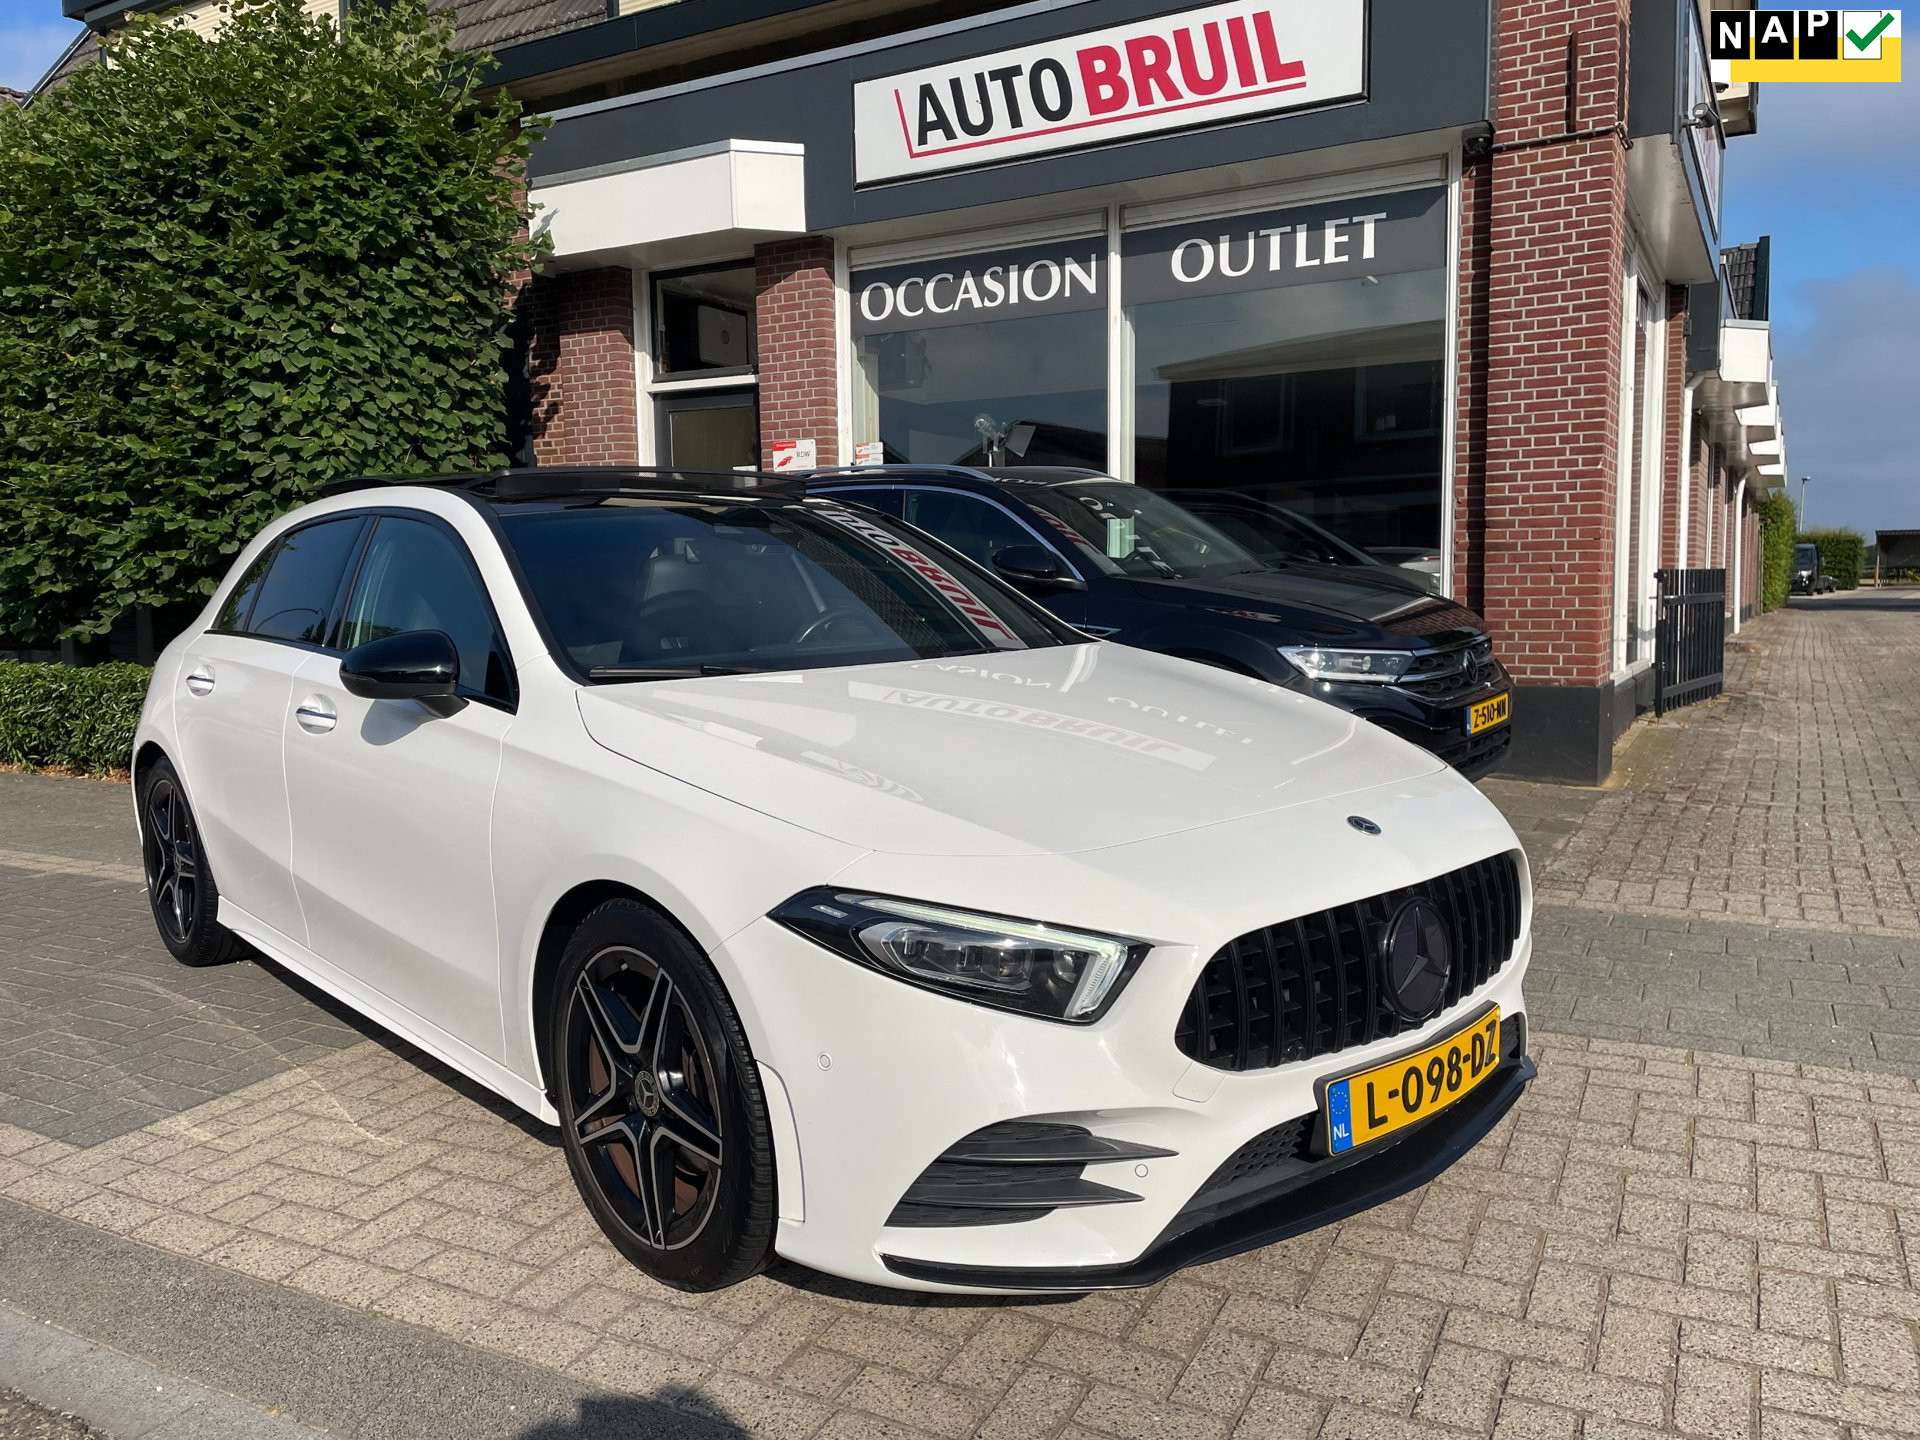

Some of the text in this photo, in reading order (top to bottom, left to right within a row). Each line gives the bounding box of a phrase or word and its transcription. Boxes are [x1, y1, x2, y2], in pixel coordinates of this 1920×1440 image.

[860, 212, 1388, 321] OCCASION OUTLET
[1366, 1018, 1497, 1130] L-098-DZ
[1333, 1123, 1349, 1141] NL
